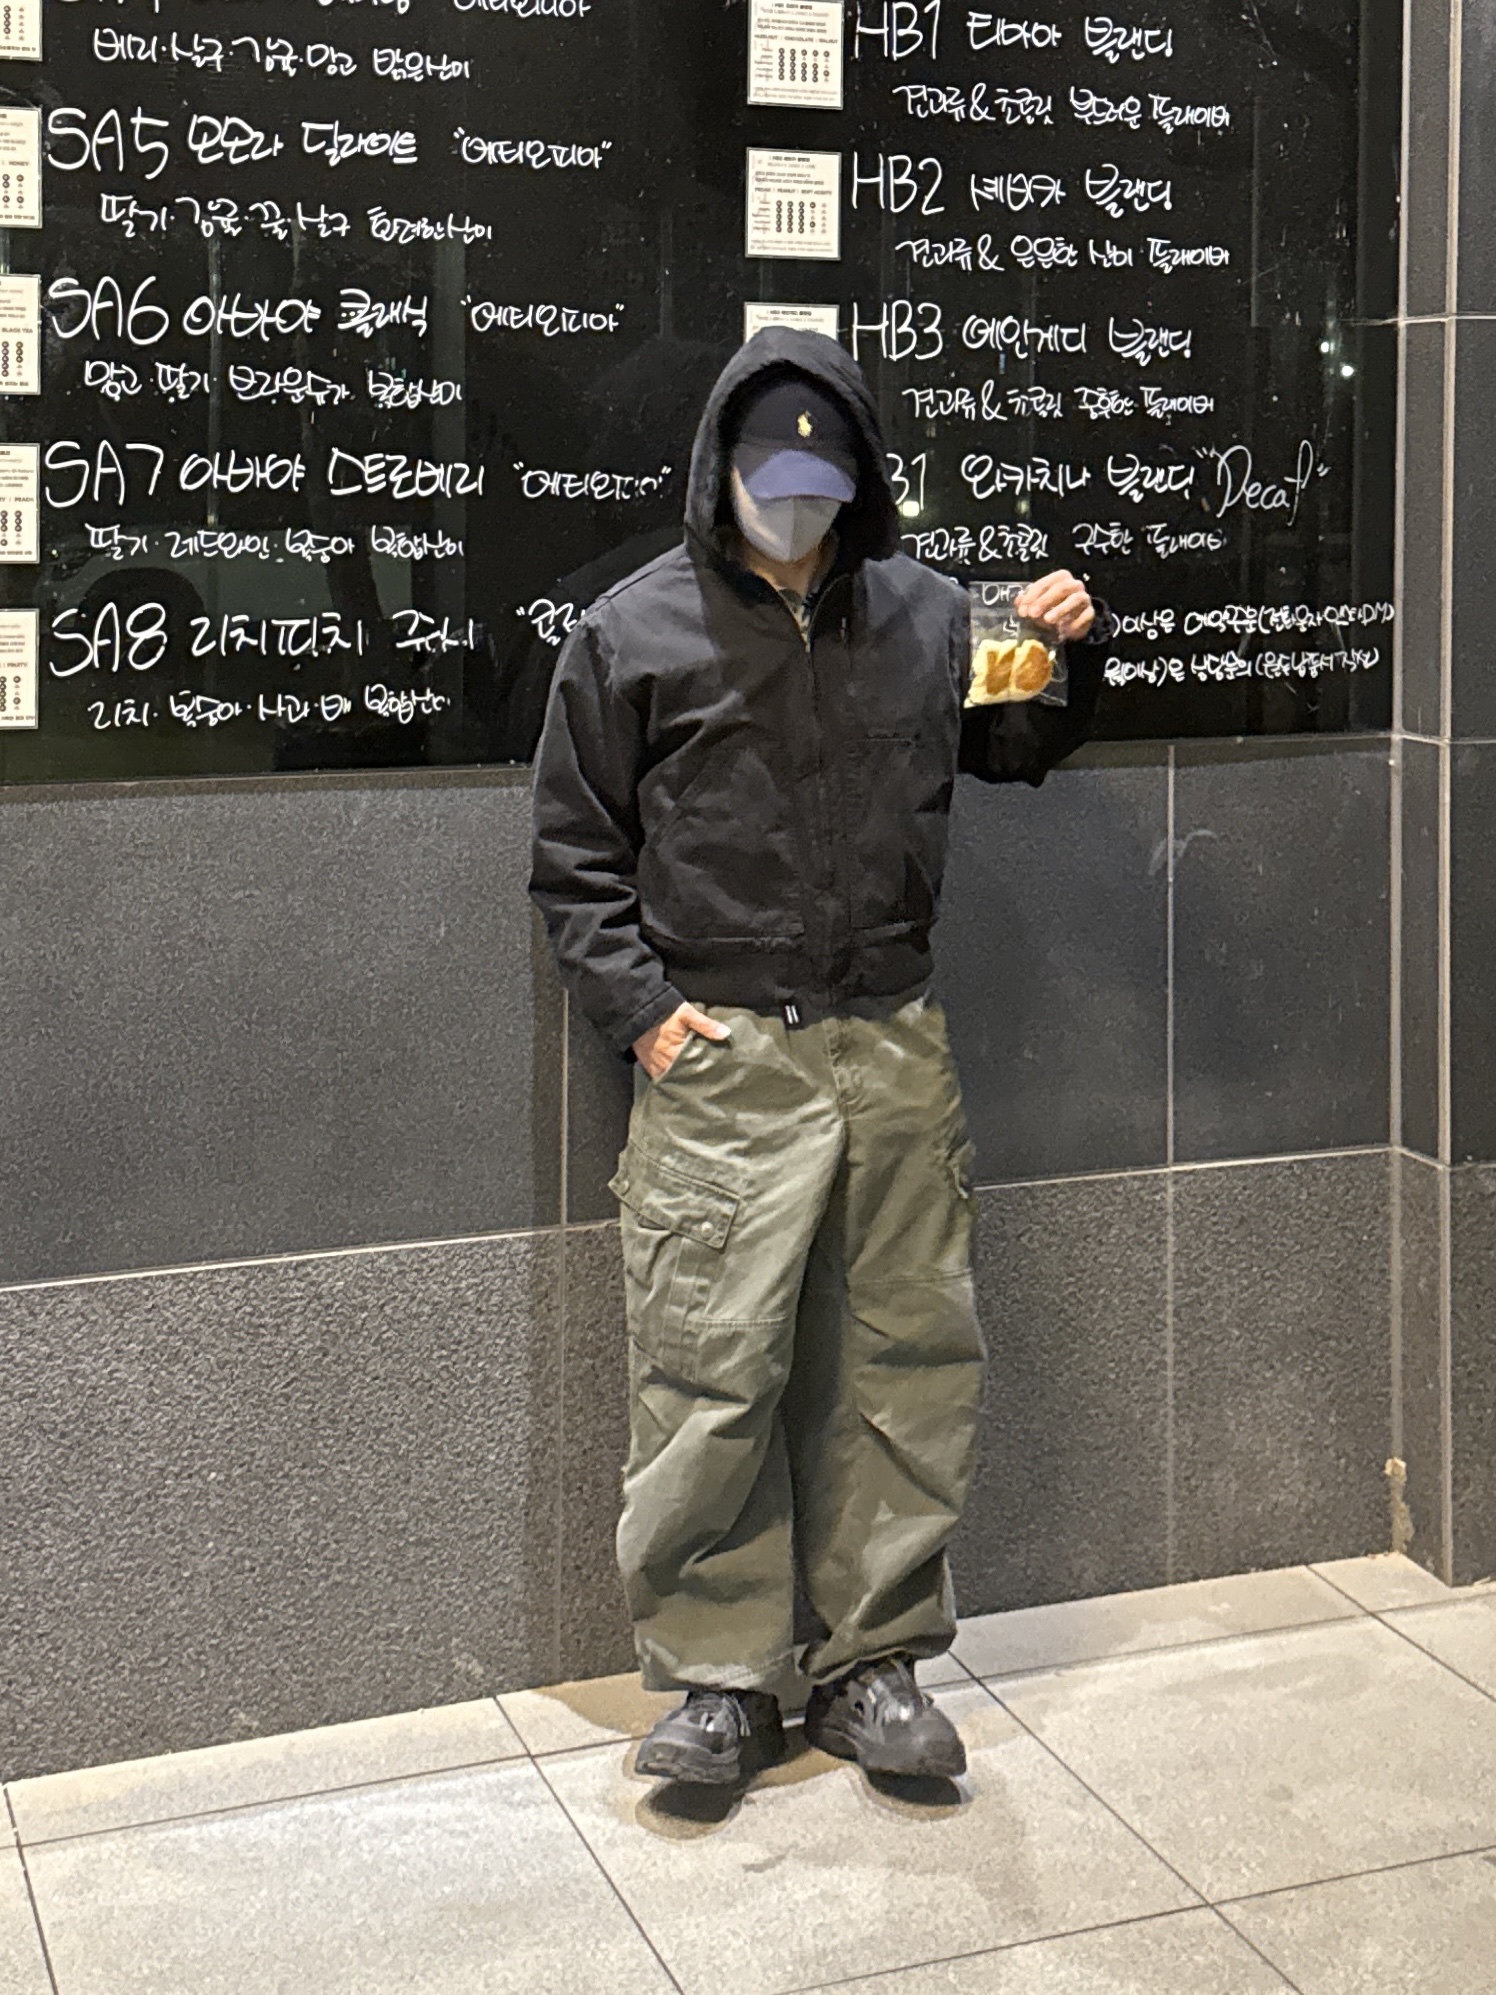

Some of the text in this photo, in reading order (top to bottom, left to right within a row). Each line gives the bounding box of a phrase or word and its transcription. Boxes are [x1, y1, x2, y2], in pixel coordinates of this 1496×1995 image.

[854, 0, 941, 61] HB1
[45, 106, 170, 180] SA5
[187, 114, 285, 165] 모모라
[851, 151, 945, 216] HB2
[1088, 238, 1133, 268] 산미
[47, 275, 170, 346] SA6
[182, 292, 322, 342] 아바야
[852, 299, 944, 362] HB3
[44, 439, 164, 509] SA7
[960, 453, 1092, 500] 와카치나
[49, 601, 168, 677] SA8
[190, 611, 363, 658] 리치피치
